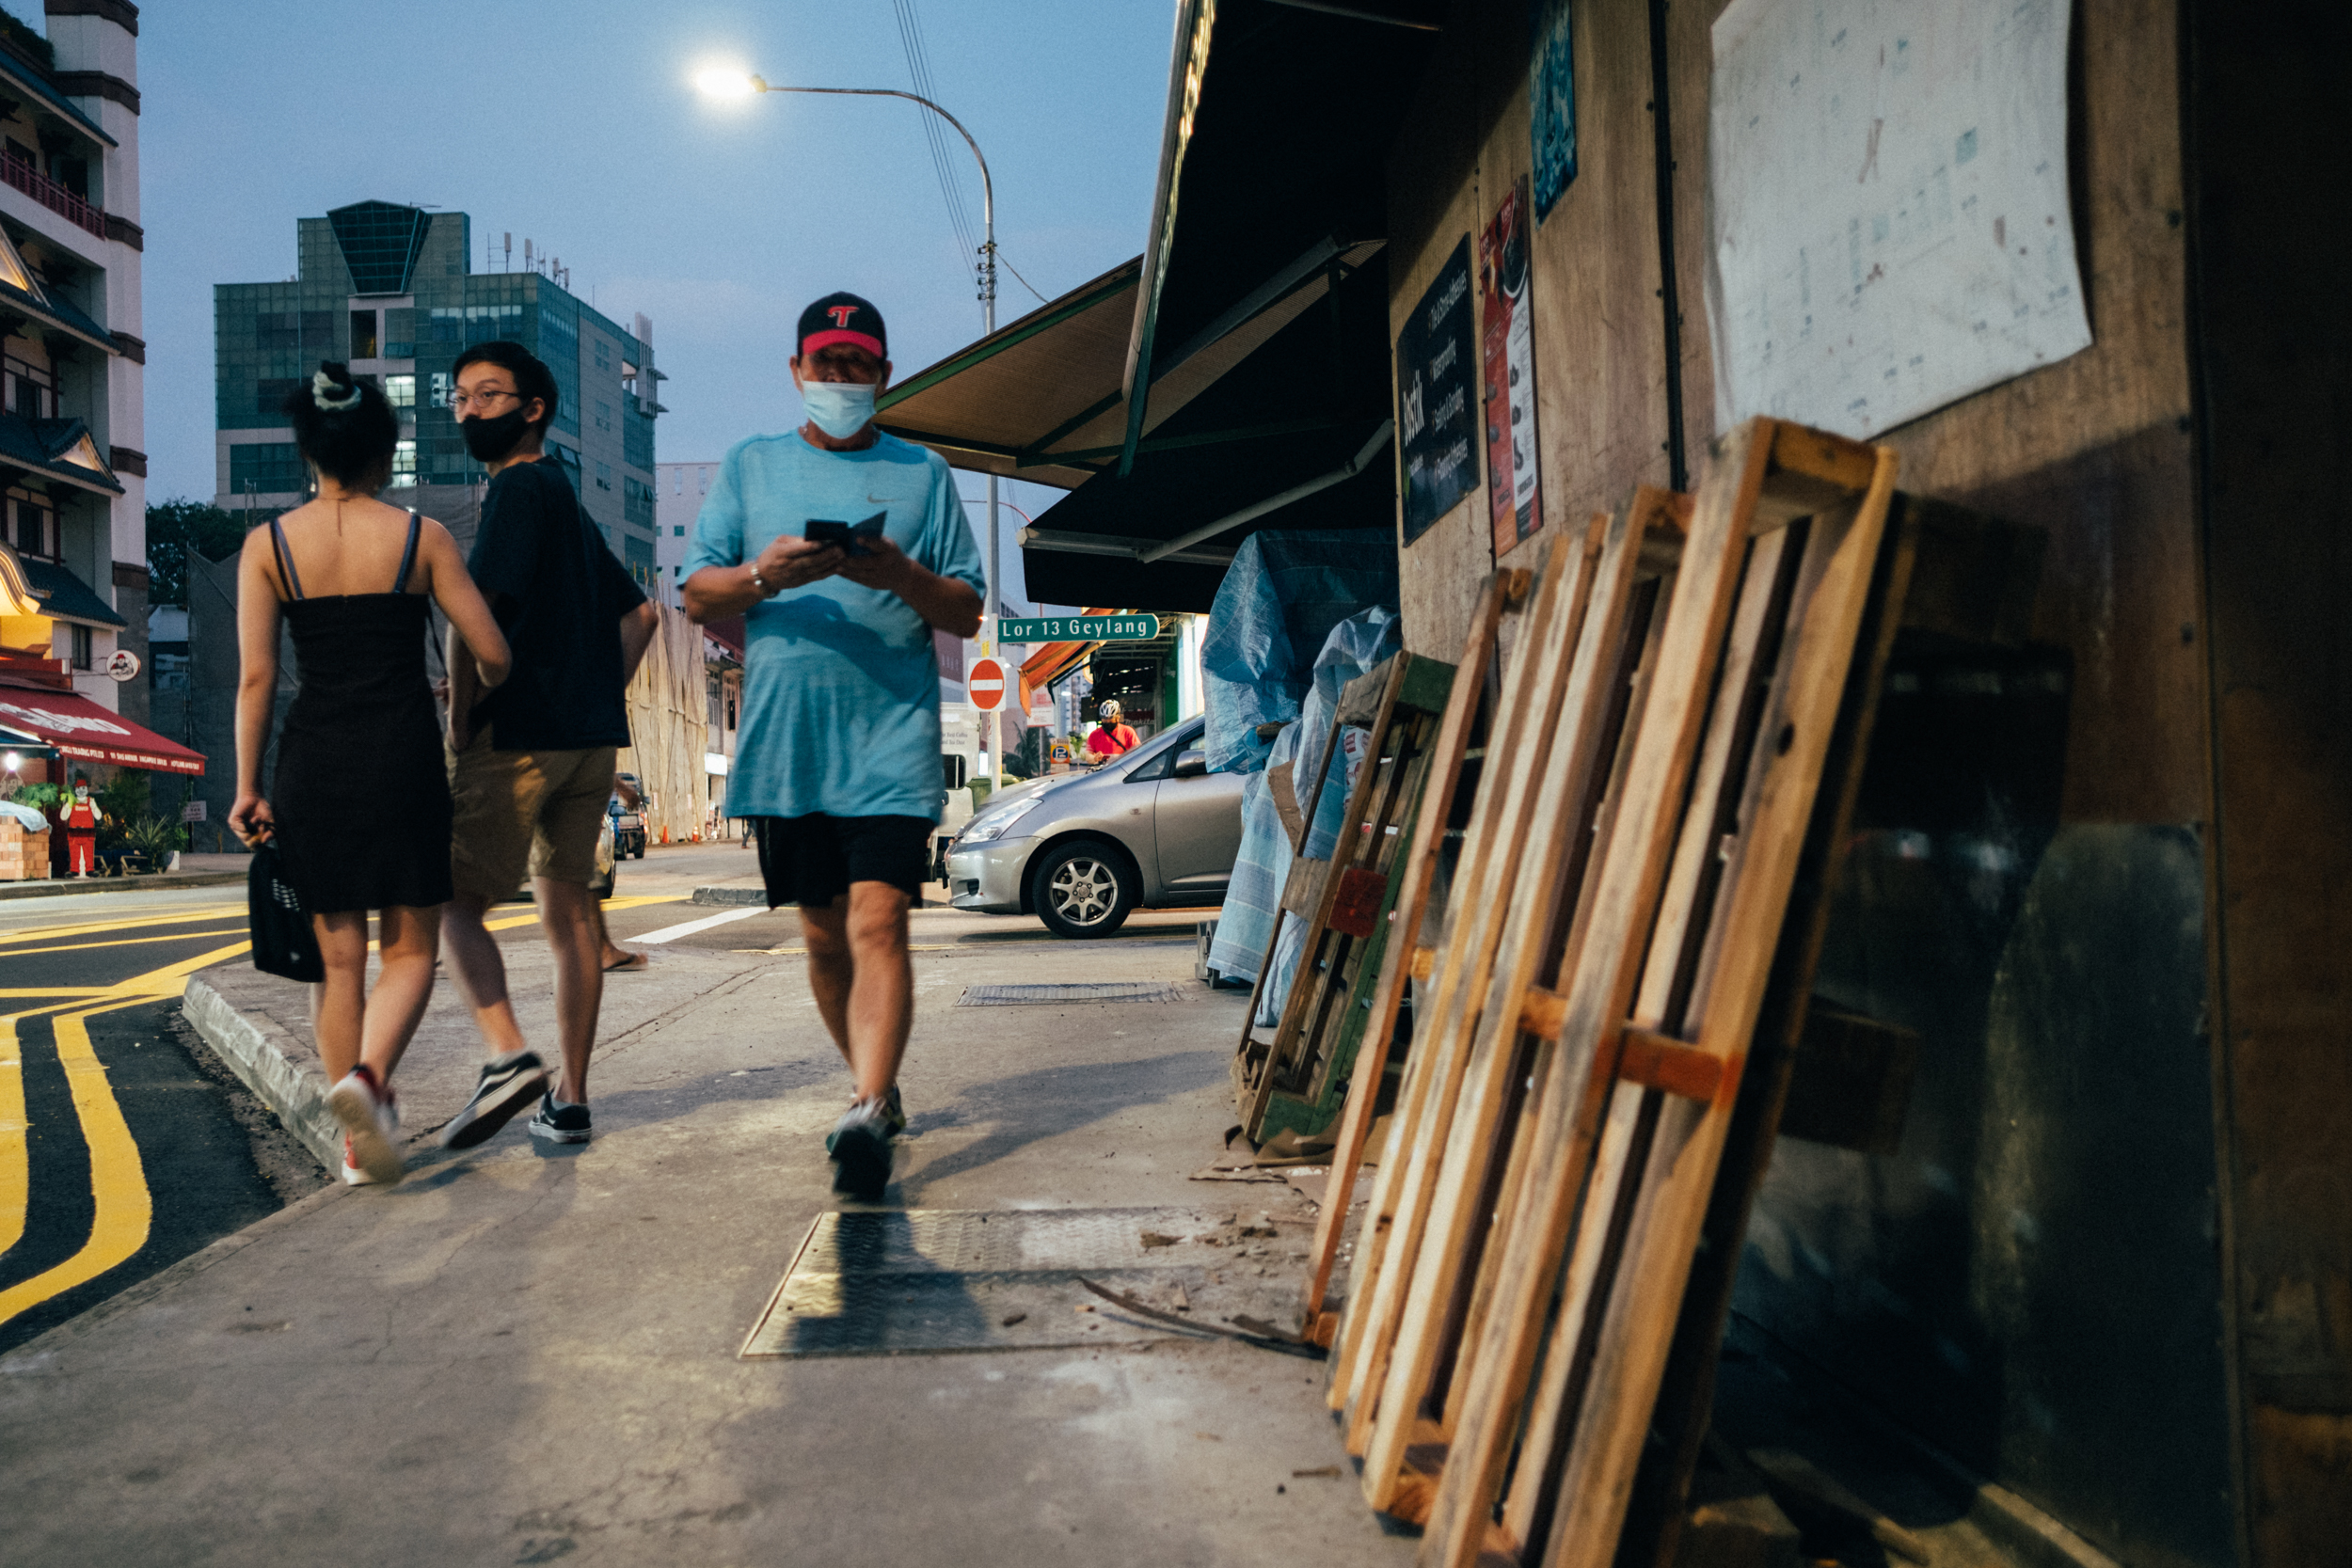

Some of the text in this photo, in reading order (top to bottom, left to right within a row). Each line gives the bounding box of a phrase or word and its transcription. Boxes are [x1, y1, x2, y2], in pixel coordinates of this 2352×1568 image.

[1449, 268, 1467, 306] Adhesives
[827, 306, 859, 327] T
[1433, 336, 1456, 383] Waterproofing
[1403, 368, 1424, 448] Bostik
[1449, 382, 1464, 420] Bonding
[1437, 451, 1451, 481] Flooring
[1450, 435, 1468, 469] Adhesives
[1003, 618, 1147, 638] Lor 13 Geylang
